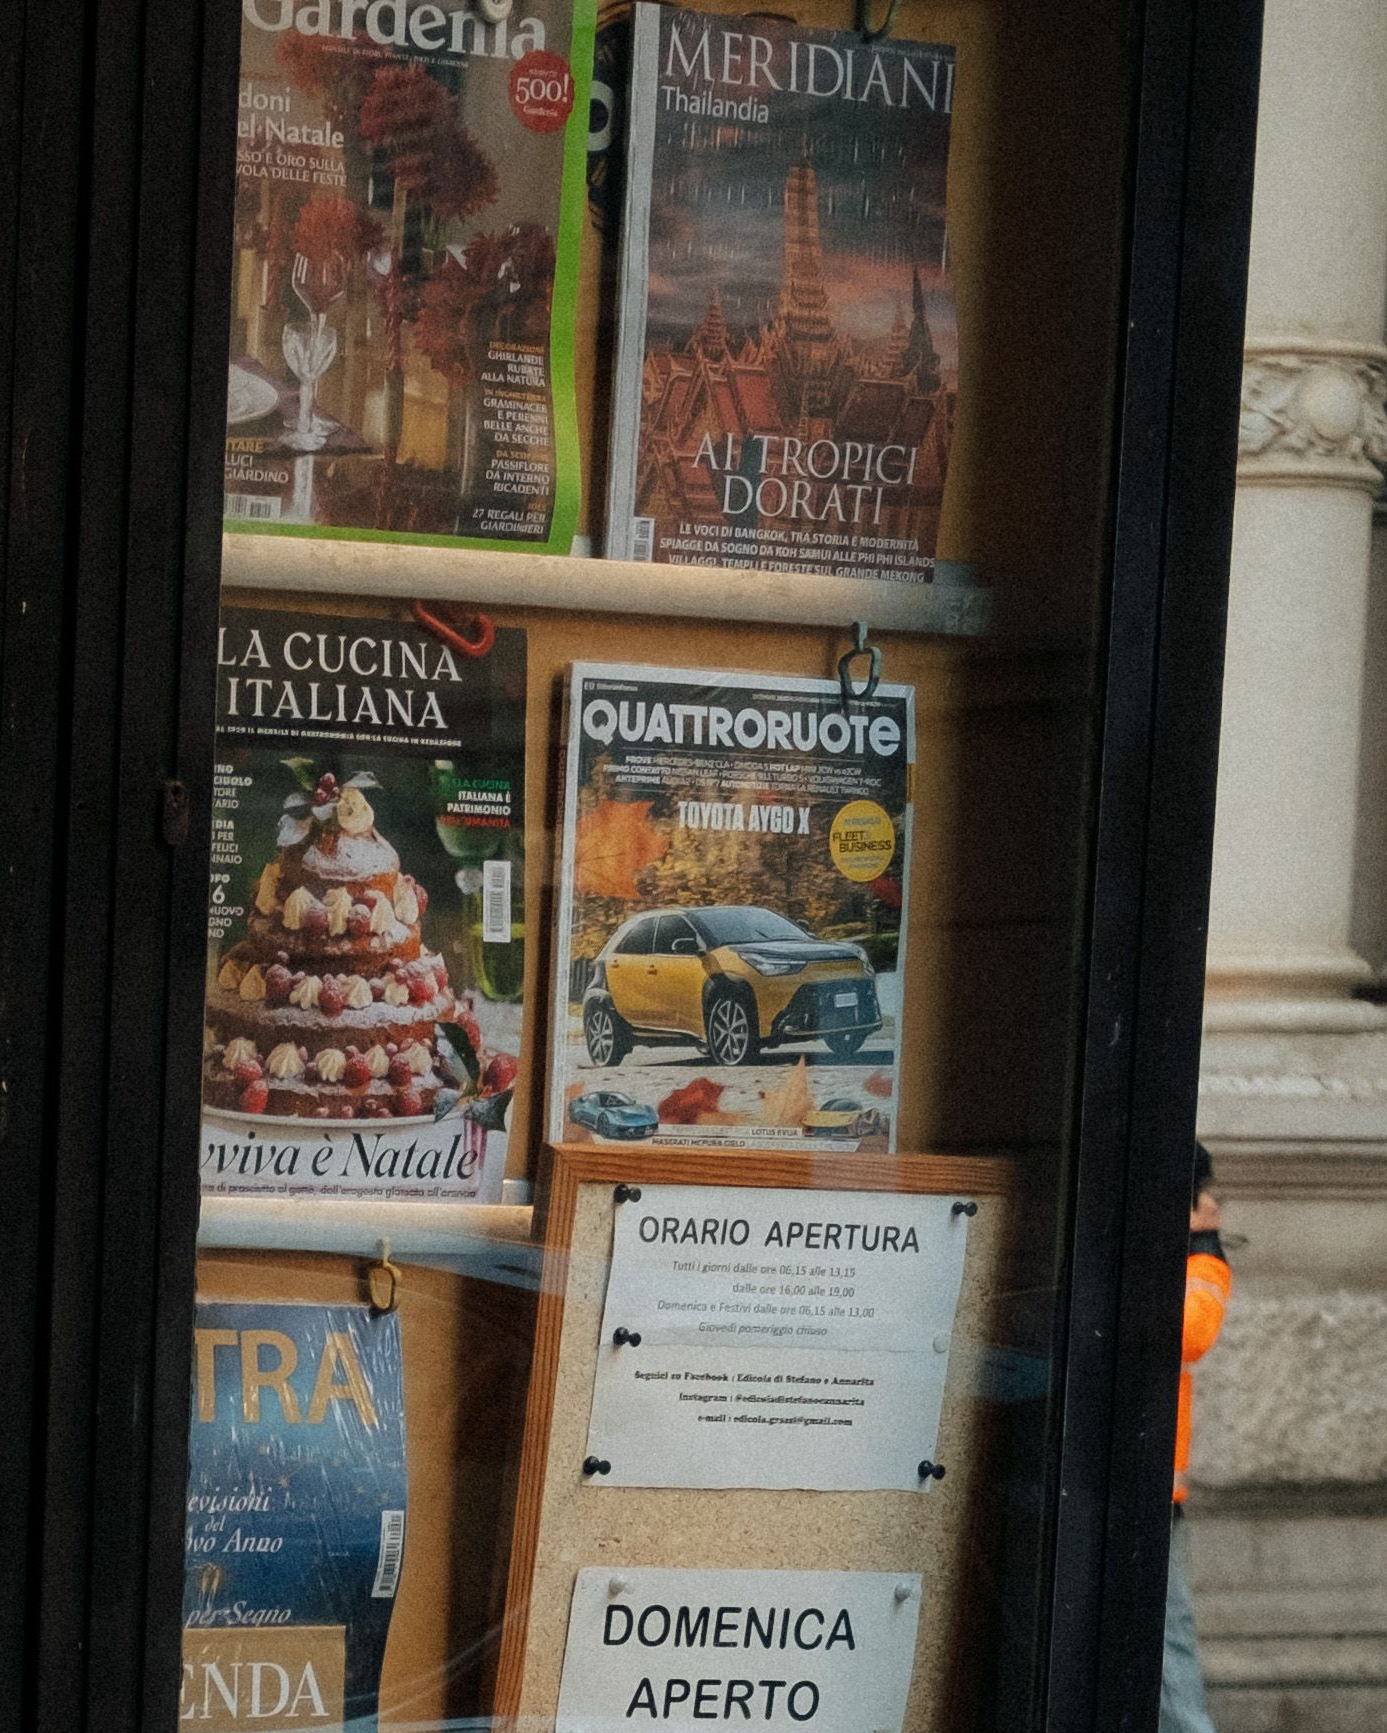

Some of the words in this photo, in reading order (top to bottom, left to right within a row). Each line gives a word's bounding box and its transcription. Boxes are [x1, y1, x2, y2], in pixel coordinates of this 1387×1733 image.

[665, 20, 954, 114] MERIDIANI
[515, 74, 569, 104] 500!
[661, 85, 769, 123] Thailandia
[265, 116, 344, 149] Natale
[506, 374, 546, 387] NATURA
[491, 459, 549, 473] PASSIFLORE
[691, 432, 733, 470] AI
[753, 435, 917, 485] TROPICI
[722, 475, 883, 525] DORATI
[680, 523, 692, 535] LE
[693, 525, 719, 538] VOCI
[720, 527, 732, 538] DI
[734, 528, 787, 543] BANGKOK,
[791, 531, 811, 543] TRA
[812, 533, 849, 547] STORIA
[859, 535, 919, 551] MODERNITÀ
[217, 627, 271, 667] LA
[283, 632, 463, 681] CUCINA
[227, 677, 449, 729] ITALIANA
[447, 803, 511, 816] PATRIMONIO
[458, 790, 503, 803] ITALIANA
[678, 801, 745, 831] TOYOTA
[748, 805, 795, 834] AYGO
[797, 807, 811, 834] X
[839, 840, 892, 853] BUSINESS
[311, 1134, 333, 1176] è
[338, 1133, 478, 1180] Natale
[639, 1216, 750, 1246] ORARIO
[764, 1221, 920, 1253] APERTURA
[702, 1262, 731, 1275] giorni
[733, 1263, 758, 1275] dalle
[760, 1267, 777, 1275] ore
[809, 1266, 827, 1277] alle
[657, 1300, 707, 1312] Domenica
[719, 1303, 751, 1313] Festivi
[738, 1325, 793, 1337] pomeriggio
[796, 1327, 828, 1337] chiuso
[222, 1528, 283, 1553] Anno
[603, 1605, 855, 1650] DOMENICA
[626, 1677, 820, 1722] APERTO
